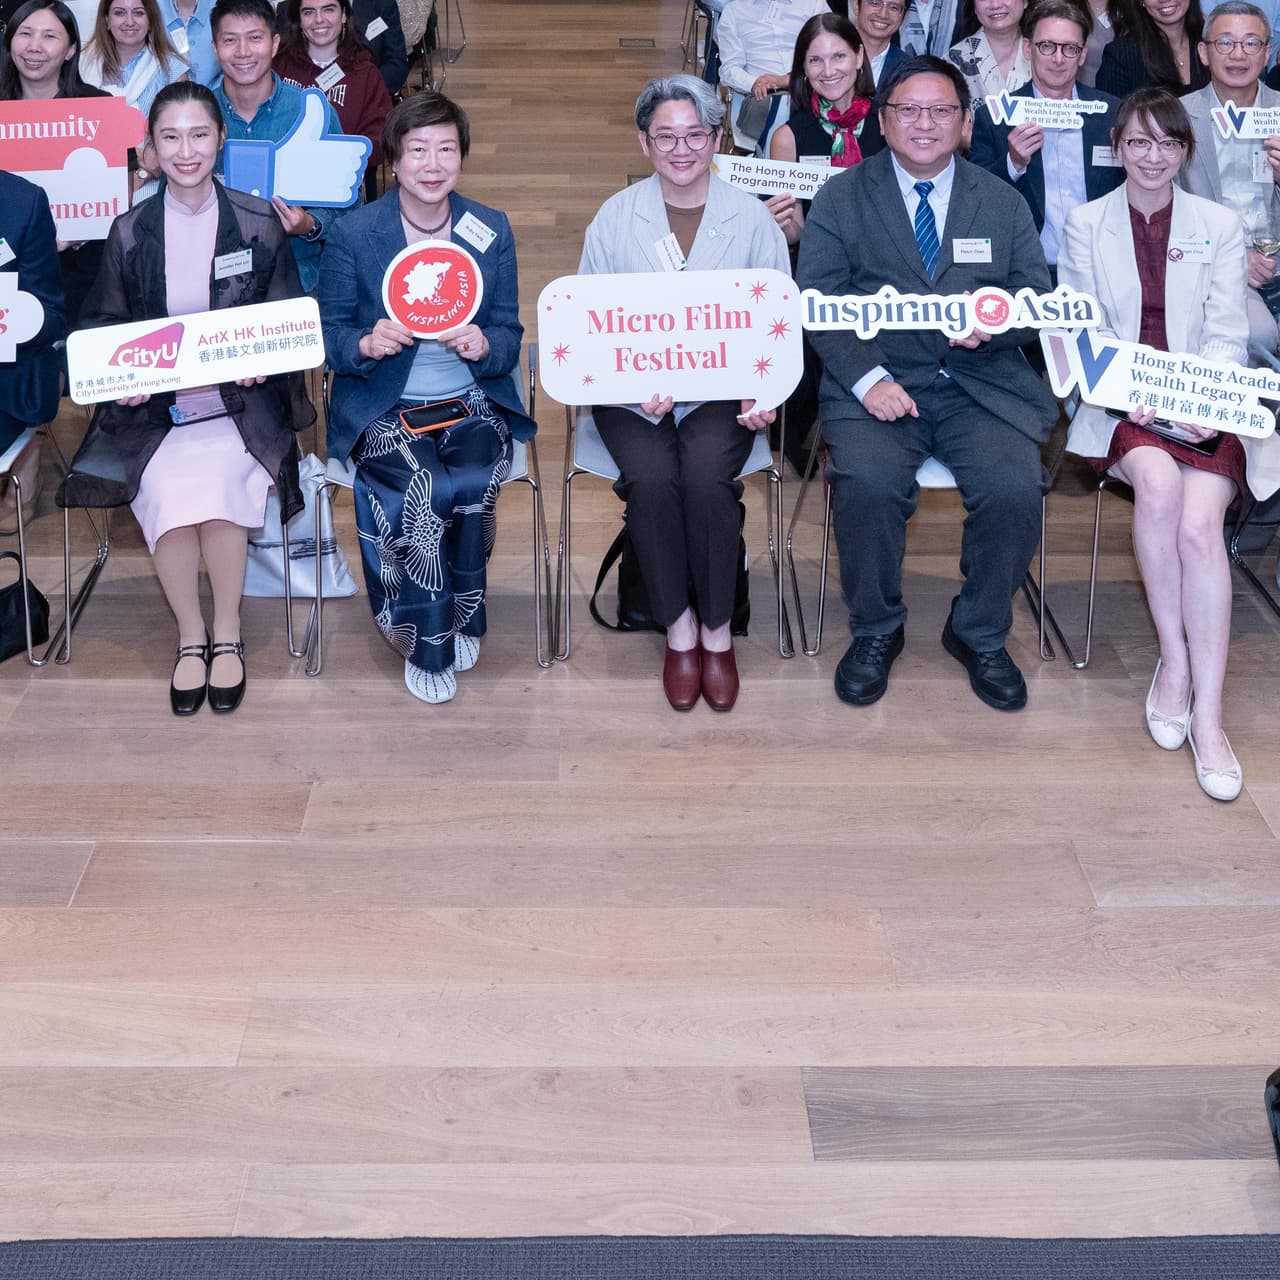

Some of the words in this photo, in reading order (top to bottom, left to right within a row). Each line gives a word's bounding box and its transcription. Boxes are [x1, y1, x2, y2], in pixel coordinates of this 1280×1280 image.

[1024, 101, 1043, 109] Hong
[730, 174, 796, 191] Programme
[799, 184, 814, 192] on
[731, 163, 752, 174] The
[756, 165, 786, 179] Hong
[789, 169, 819, 182] Kong
[407, 299, 466, 327] INSPIRING
[457, 270, 469, 298] ASIA
[808, 291, 966, 333] Inspiring
[1018, 291, 1094, 322] Asia
[197, 330, 229, 347] ArtX
[234, 326, 257, 340] HK
[261, 319, 317, 338] Institute
[586, 306, 675, 335] Micro
[684, 303, 753, 332] Film
[117, 341, 178, 369] CityU
[198, 332, 319, 364] 香港藝文創新研究院
[615, 341, 729, 373] Festival
[1132, 351, 1177, 375] Hong
[1181, 361, 1225, 383] Kong
[76, 390, 92, 398] City
[93, 384, 130, 395] University
[131, 381, 140, 389] of
[140, 379, 161, 387] Hong
[161, 376, 182, 384] Kong
[1130, 369, 1186, 392] Wealth
[1191, 381, 1247, 405] Legacy
[1127, 389, 1266, 430] 香港財富傳承學院
